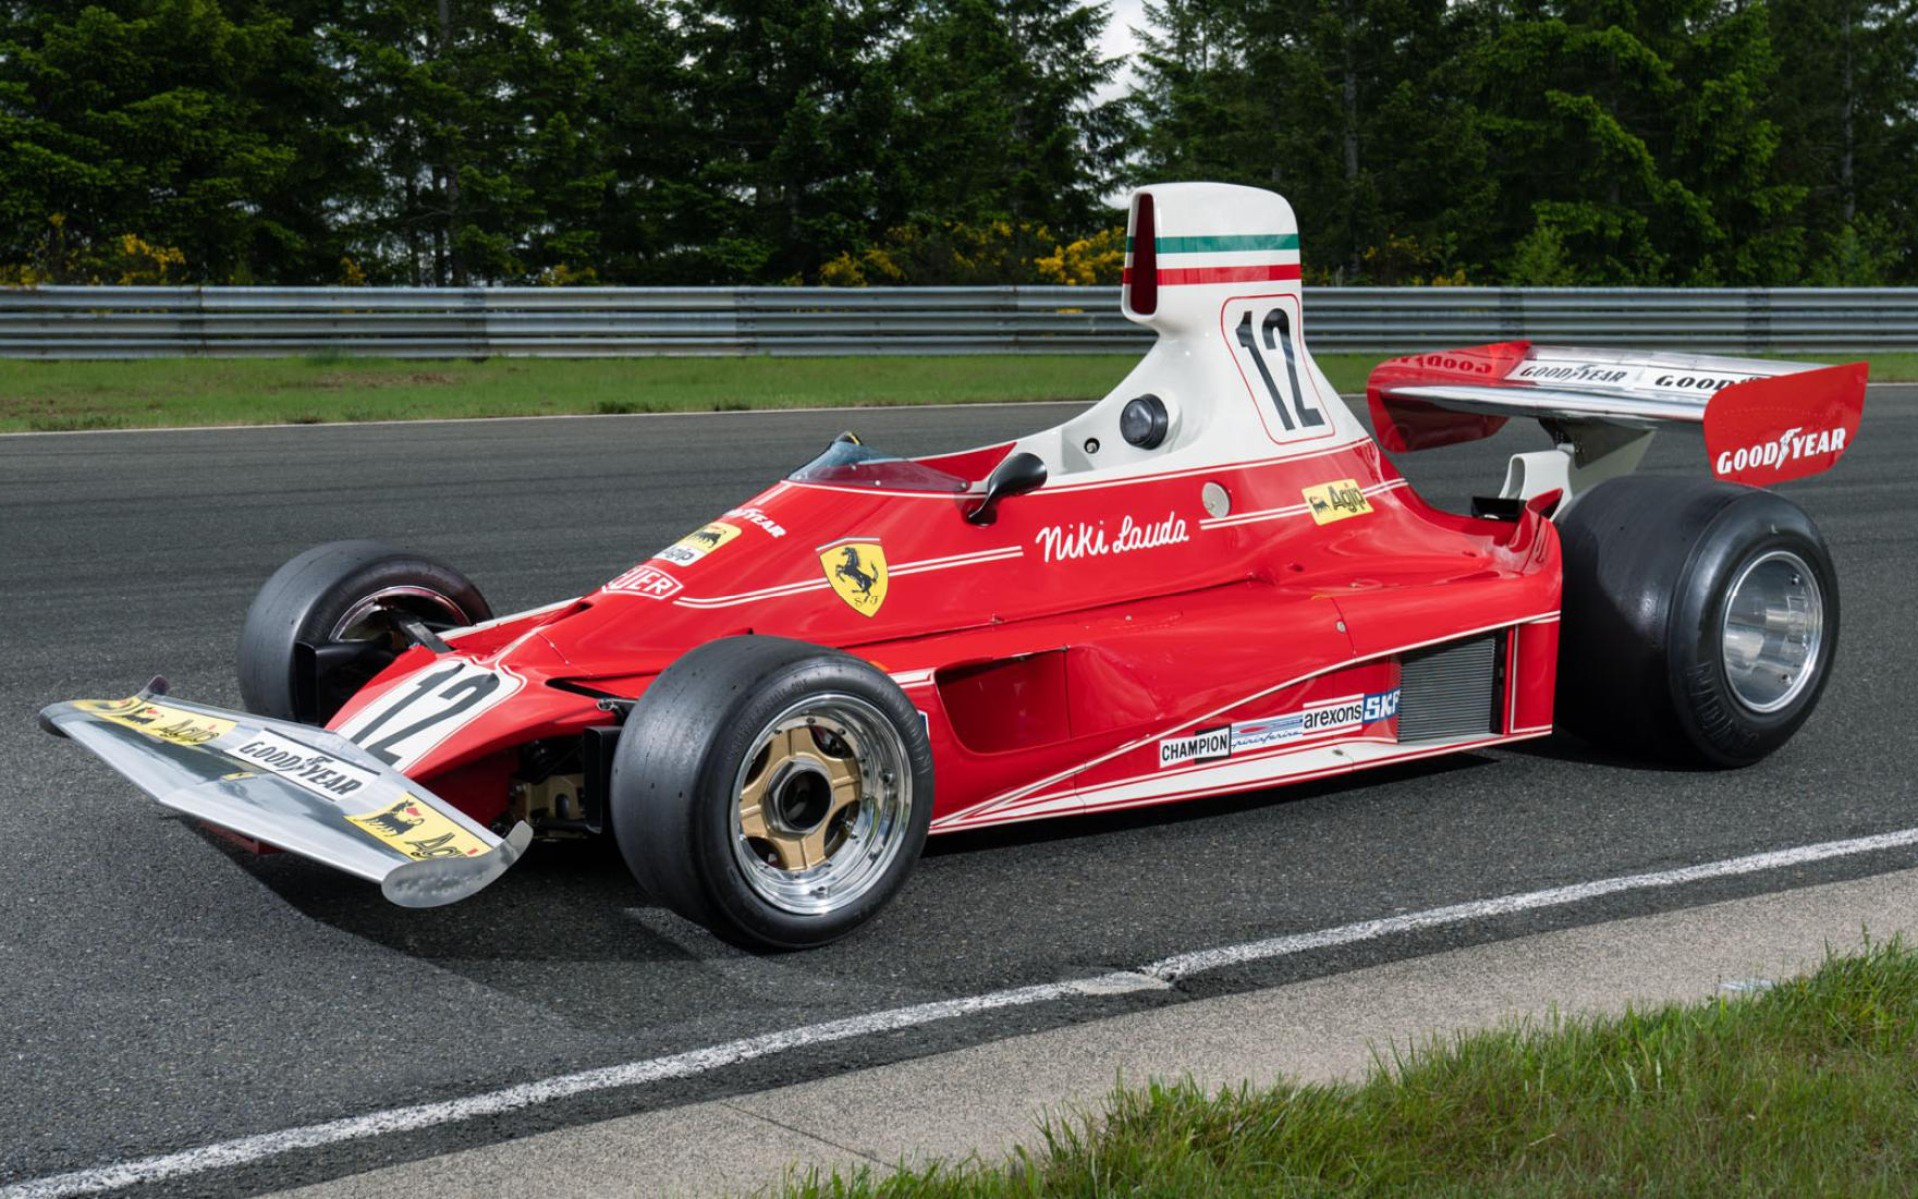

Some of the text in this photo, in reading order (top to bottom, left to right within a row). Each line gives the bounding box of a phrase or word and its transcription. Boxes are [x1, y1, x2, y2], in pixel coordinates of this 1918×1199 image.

[1235, 308, 1325, 431] 12
[1520, 364, 1627, 383] GOODYEAR
[1716, 427, 1846, 475] GOODYEAR
[1328, 482, 1366, 513] Agip
[1035, 511, 1190, 563] Niki Lauda
[349, 663, 500, 766] 12
[1304, 703, 1362, 729] arexons
[1364, 690, 1400, 720] SKF
[1162, 734, 1228, 761] CHAMPION
[239, 741, 362, 795] GOODYEAR
